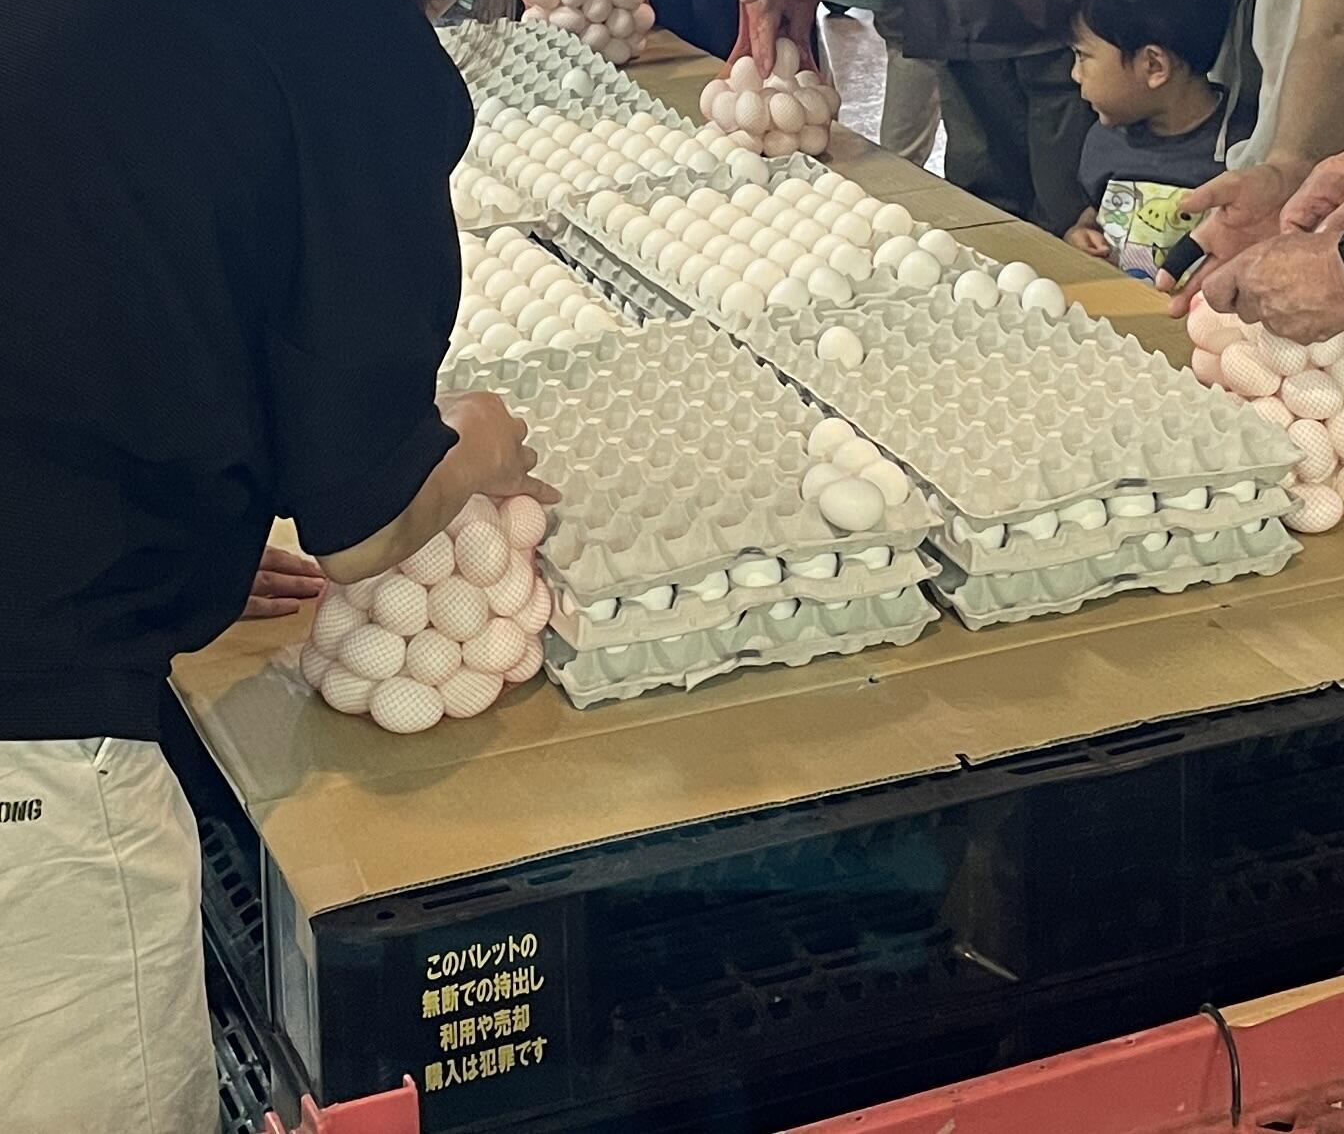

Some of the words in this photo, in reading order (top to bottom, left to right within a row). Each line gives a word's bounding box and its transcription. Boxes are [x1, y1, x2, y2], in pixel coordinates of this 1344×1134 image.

[426, 933, 537, 980] このパレットの
[421, 965, 544, 1018] 無断での持出し
[439, 1004, 530, 1052] 利用や売却
[424, 1036, 548, 1093] 購入は犯罪です
